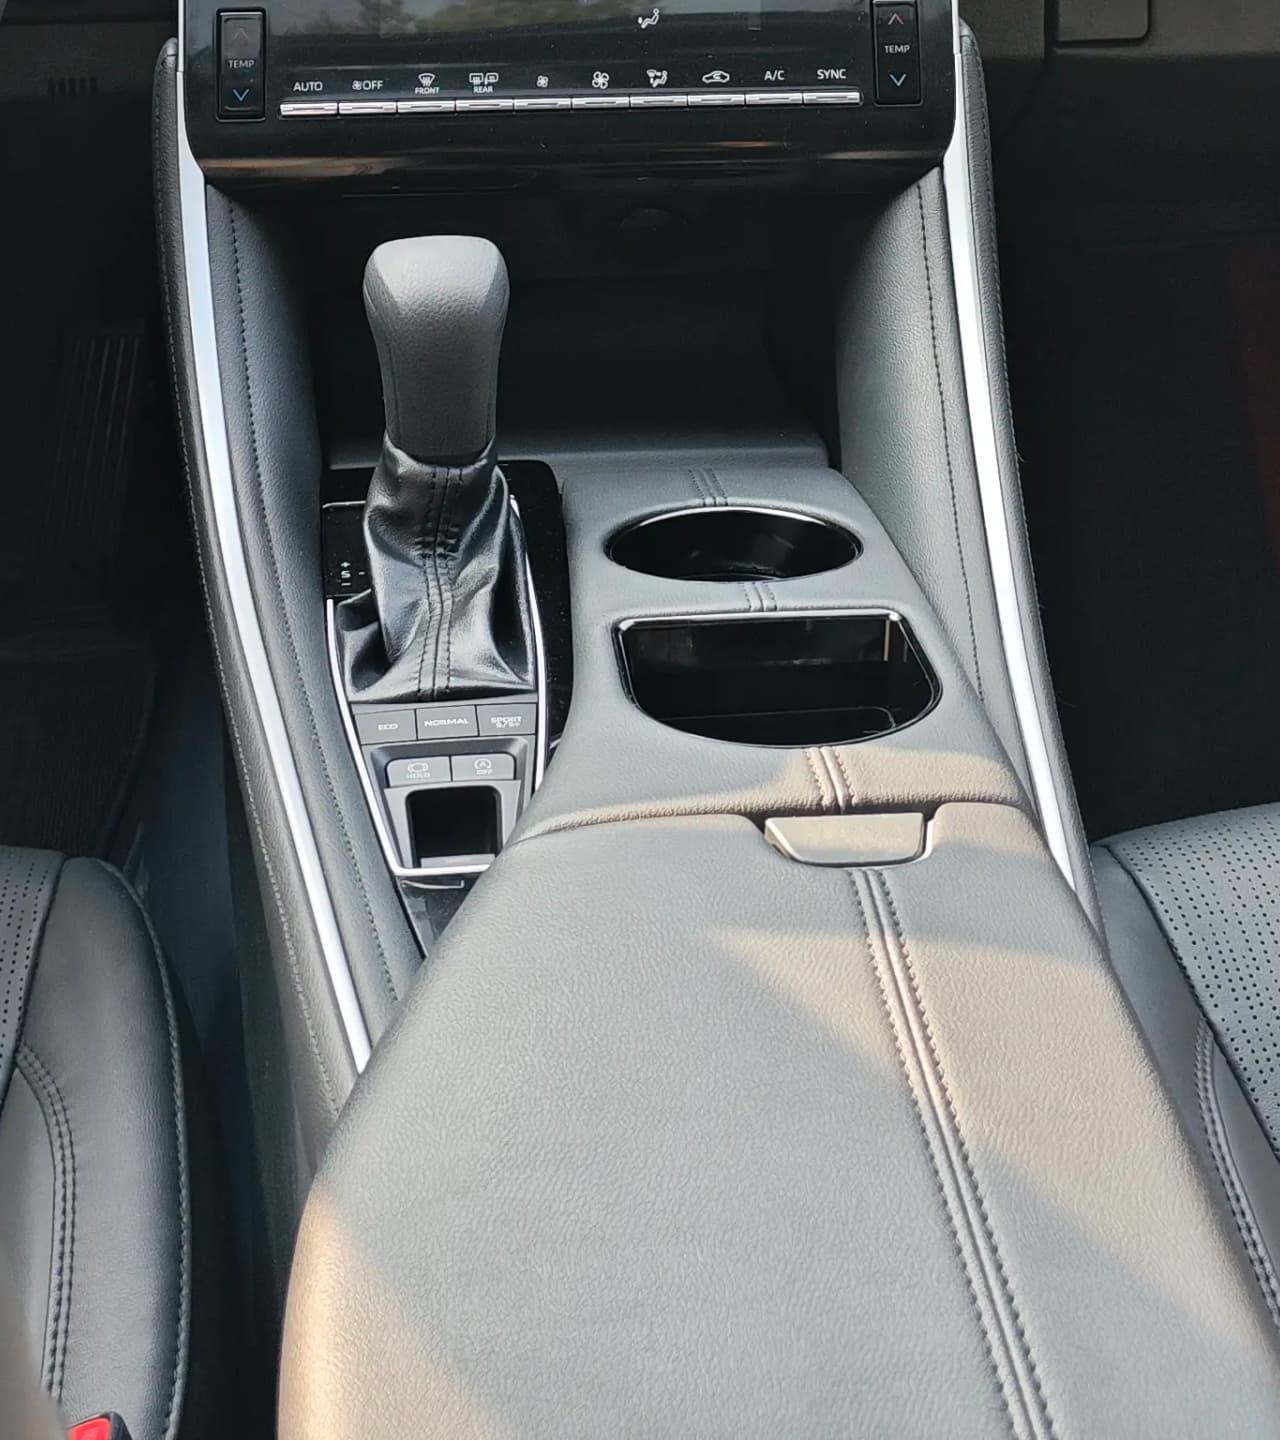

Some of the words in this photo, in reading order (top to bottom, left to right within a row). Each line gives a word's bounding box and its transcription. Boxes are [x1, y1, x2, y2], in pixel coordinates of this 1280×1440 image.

[884, 44, 911, 54] TEMP
[227, 59, 255, 69] TEMP
[763, 70, 785, 81] A/C
[816, 68, 848, 80] SYNC
[292, 81, 323, 92] AUTO
[363, 80, 384, 91] OFF
[414, 86, 440, 95] FRONT
[473, 85, 494, 94] REAR
[340, 570, 351, 579] S
[377, 723, 400, 731] ECO
[423, 717, 471, 728] NORMAL
[405, 771, 431, 779] HOLD
